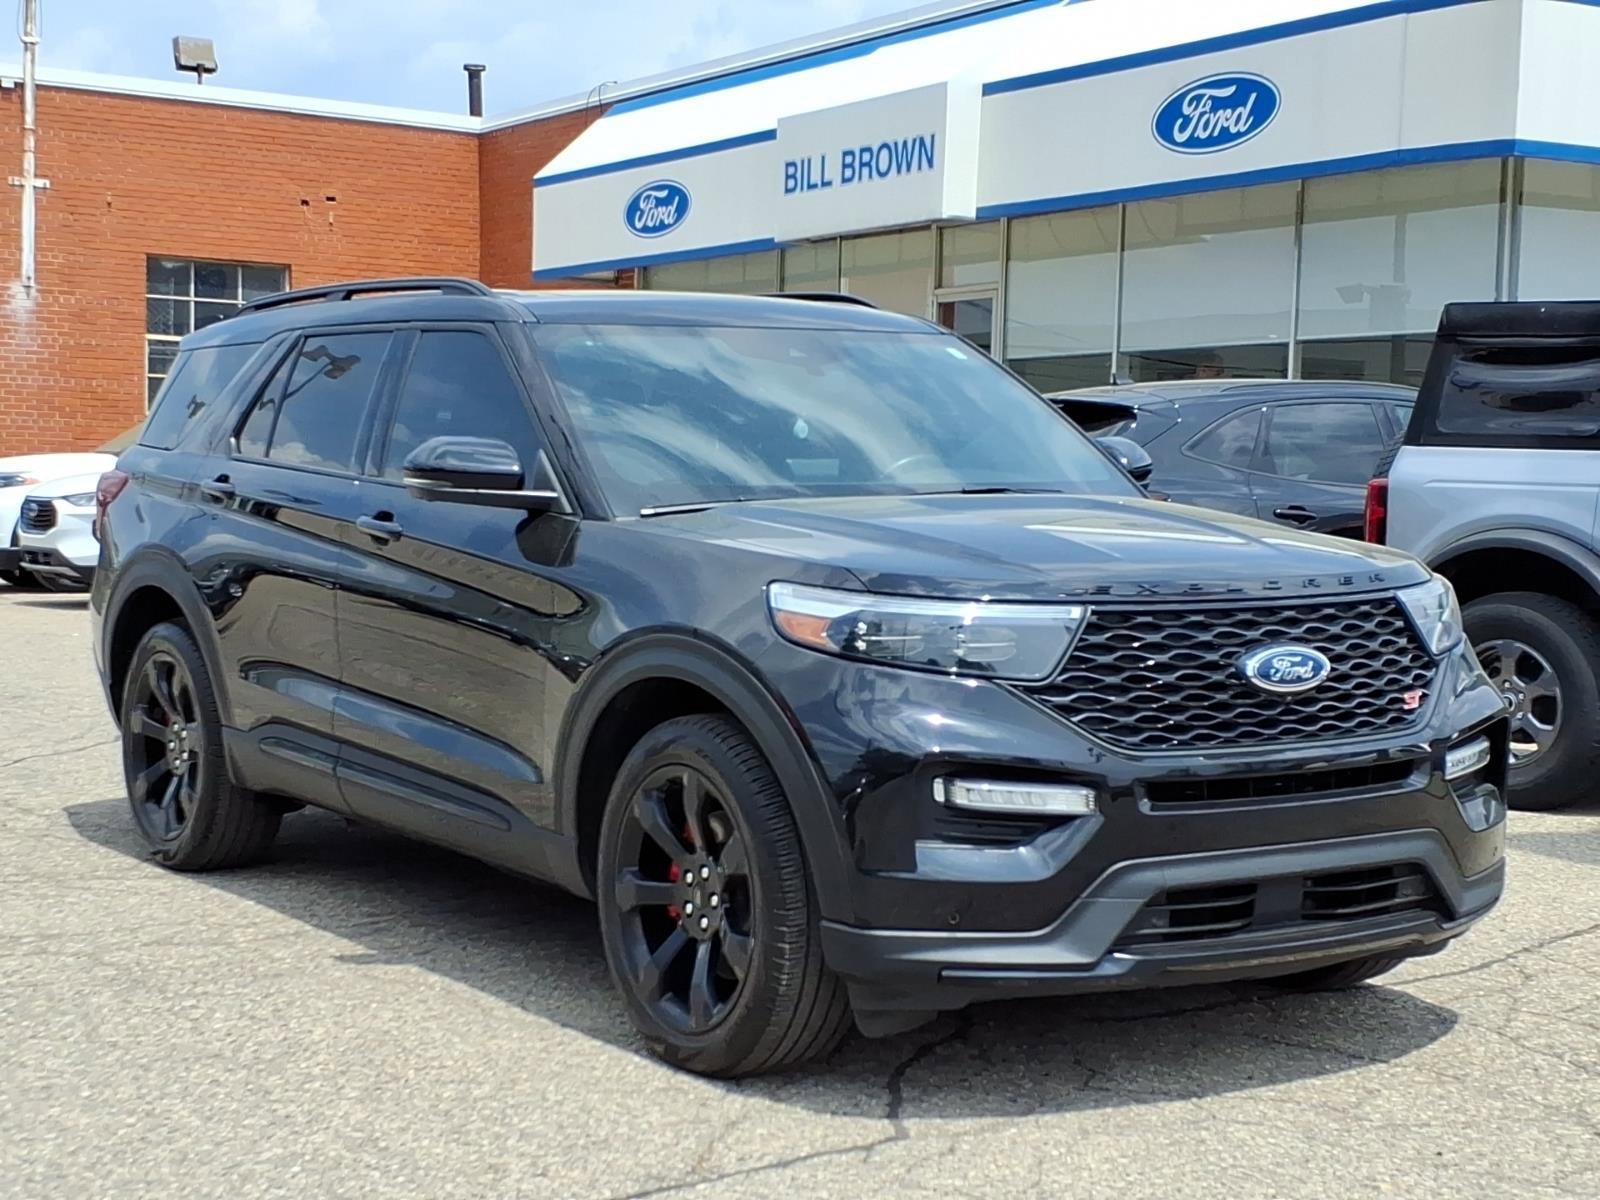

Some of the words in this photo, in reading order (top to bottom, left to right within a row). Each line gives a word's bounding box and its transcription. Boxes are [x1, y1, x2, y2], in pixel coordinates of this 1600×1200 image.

[1173, 84, 1258, 143] Ford
[784, 155, 833, 195] BILL
[841, 133, 936, 184] BROWN
[634, 189, 680, 229] Ford
[1269, 656, 1315, 681] Ford
